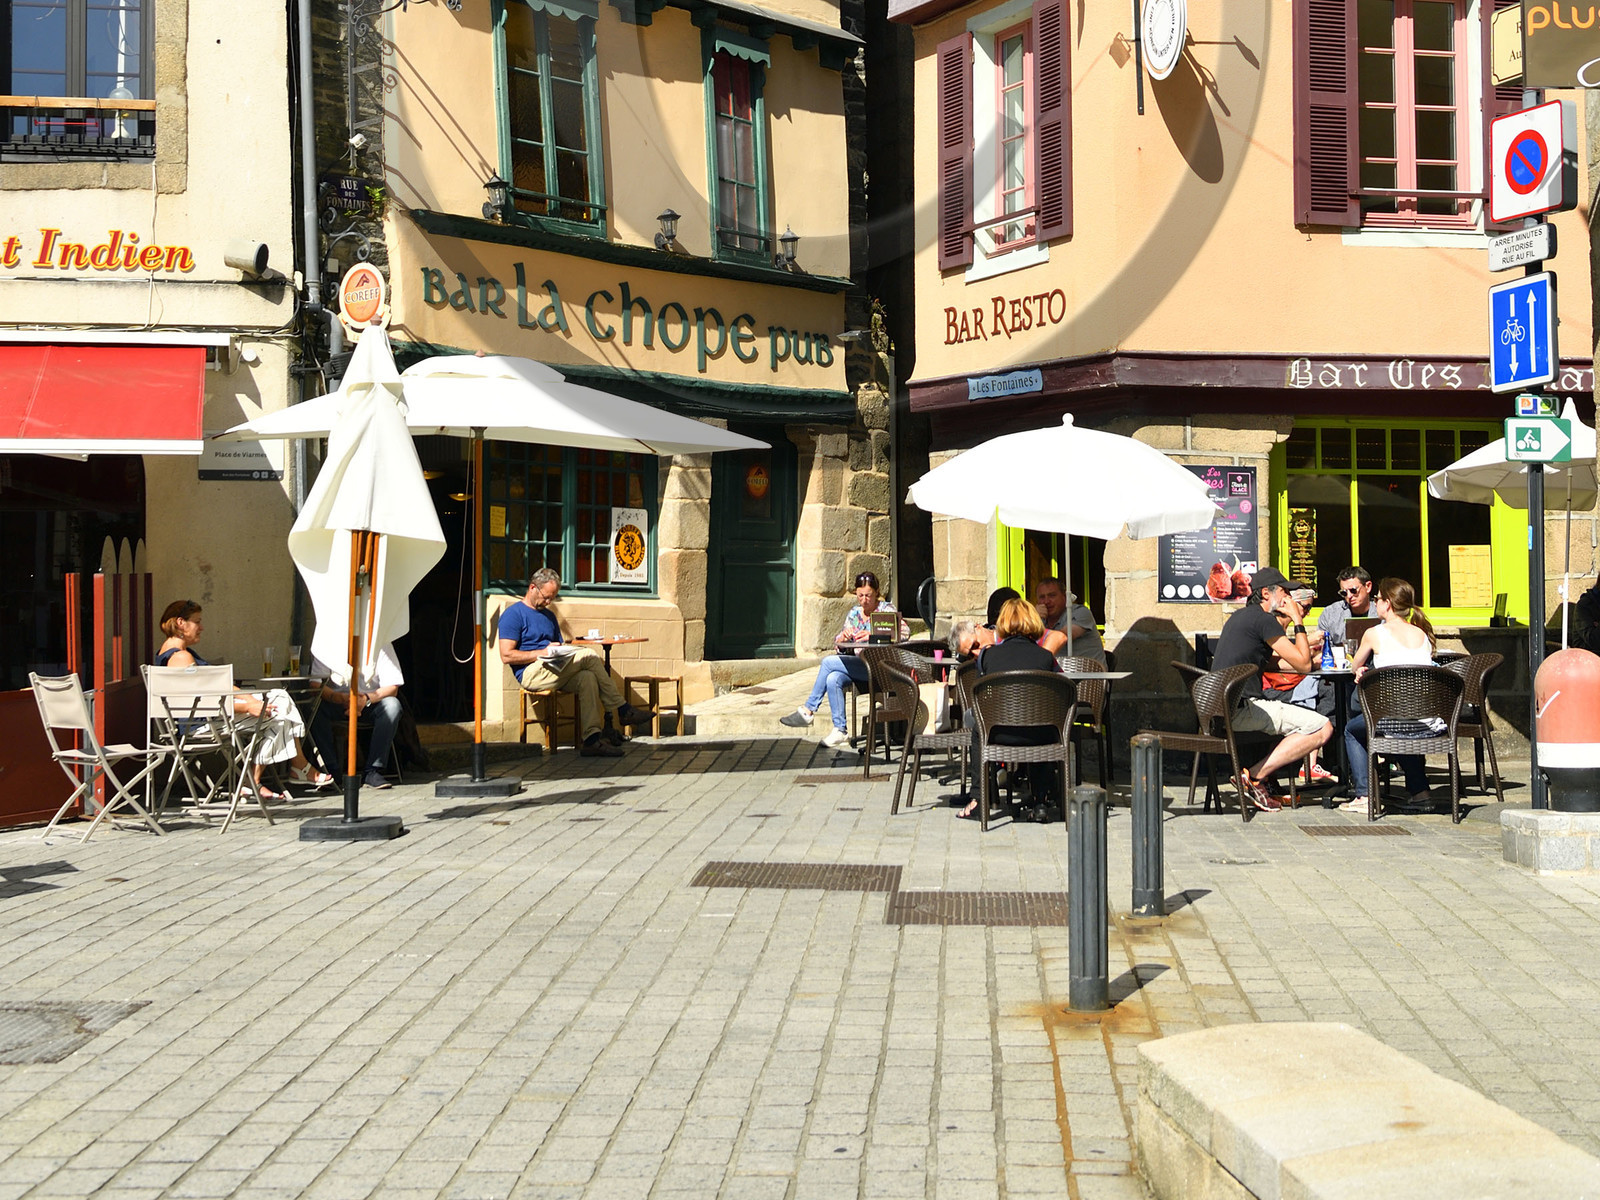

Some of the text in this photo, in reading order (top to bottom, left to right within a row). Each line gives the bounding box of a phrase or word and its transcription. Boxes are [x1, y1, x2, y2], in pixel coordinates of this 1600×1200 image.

[1527, 1, 1600, 37] plu
[341, 179, 359, 191] RUE
[344, 190, 357, 198] DES
[1494, 228, 1543, 248] ARRET MINUTES
[1503, 240, 1534, 255] AUTORISE
[0, 228, 196, 272] t Indien
[1501, 250, 1536, 265] RUE AU FIL
[344, 287, 380, 305] COREFF
[943, 288, 1067, 346] BAR RESTO
[1288, 357, 1369, 389] Bar
